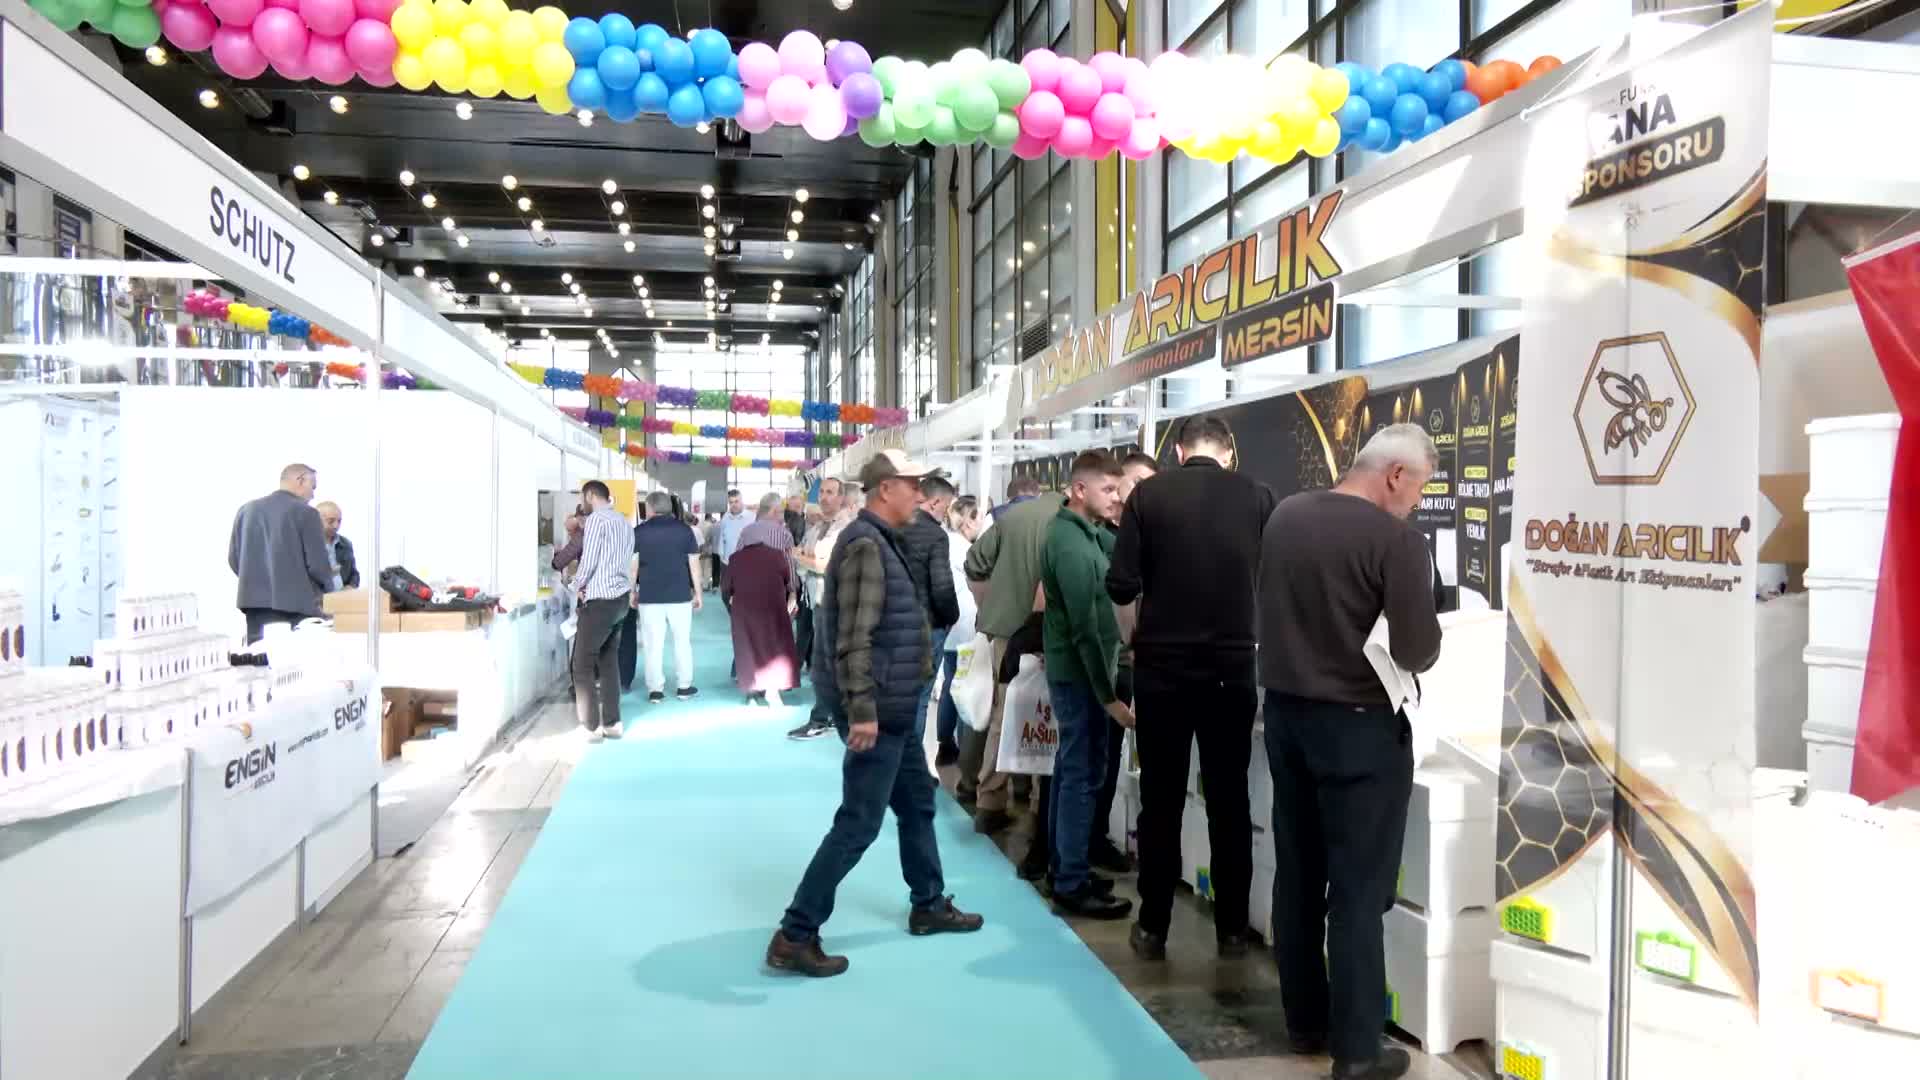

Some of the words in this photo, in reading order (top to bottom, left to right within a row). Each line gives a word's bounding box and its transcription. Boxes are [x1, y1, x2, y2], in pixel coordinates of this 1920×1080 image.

[210, 184, 296, 285] SCHUTZ
[1122, 189, 1344, 356] ARICILIK
[1526, 513, 1609, 555] DOĞAN
[1613, 523, 1742, 565] ARICILIK
[335, 695, 368, 730] ENGN
